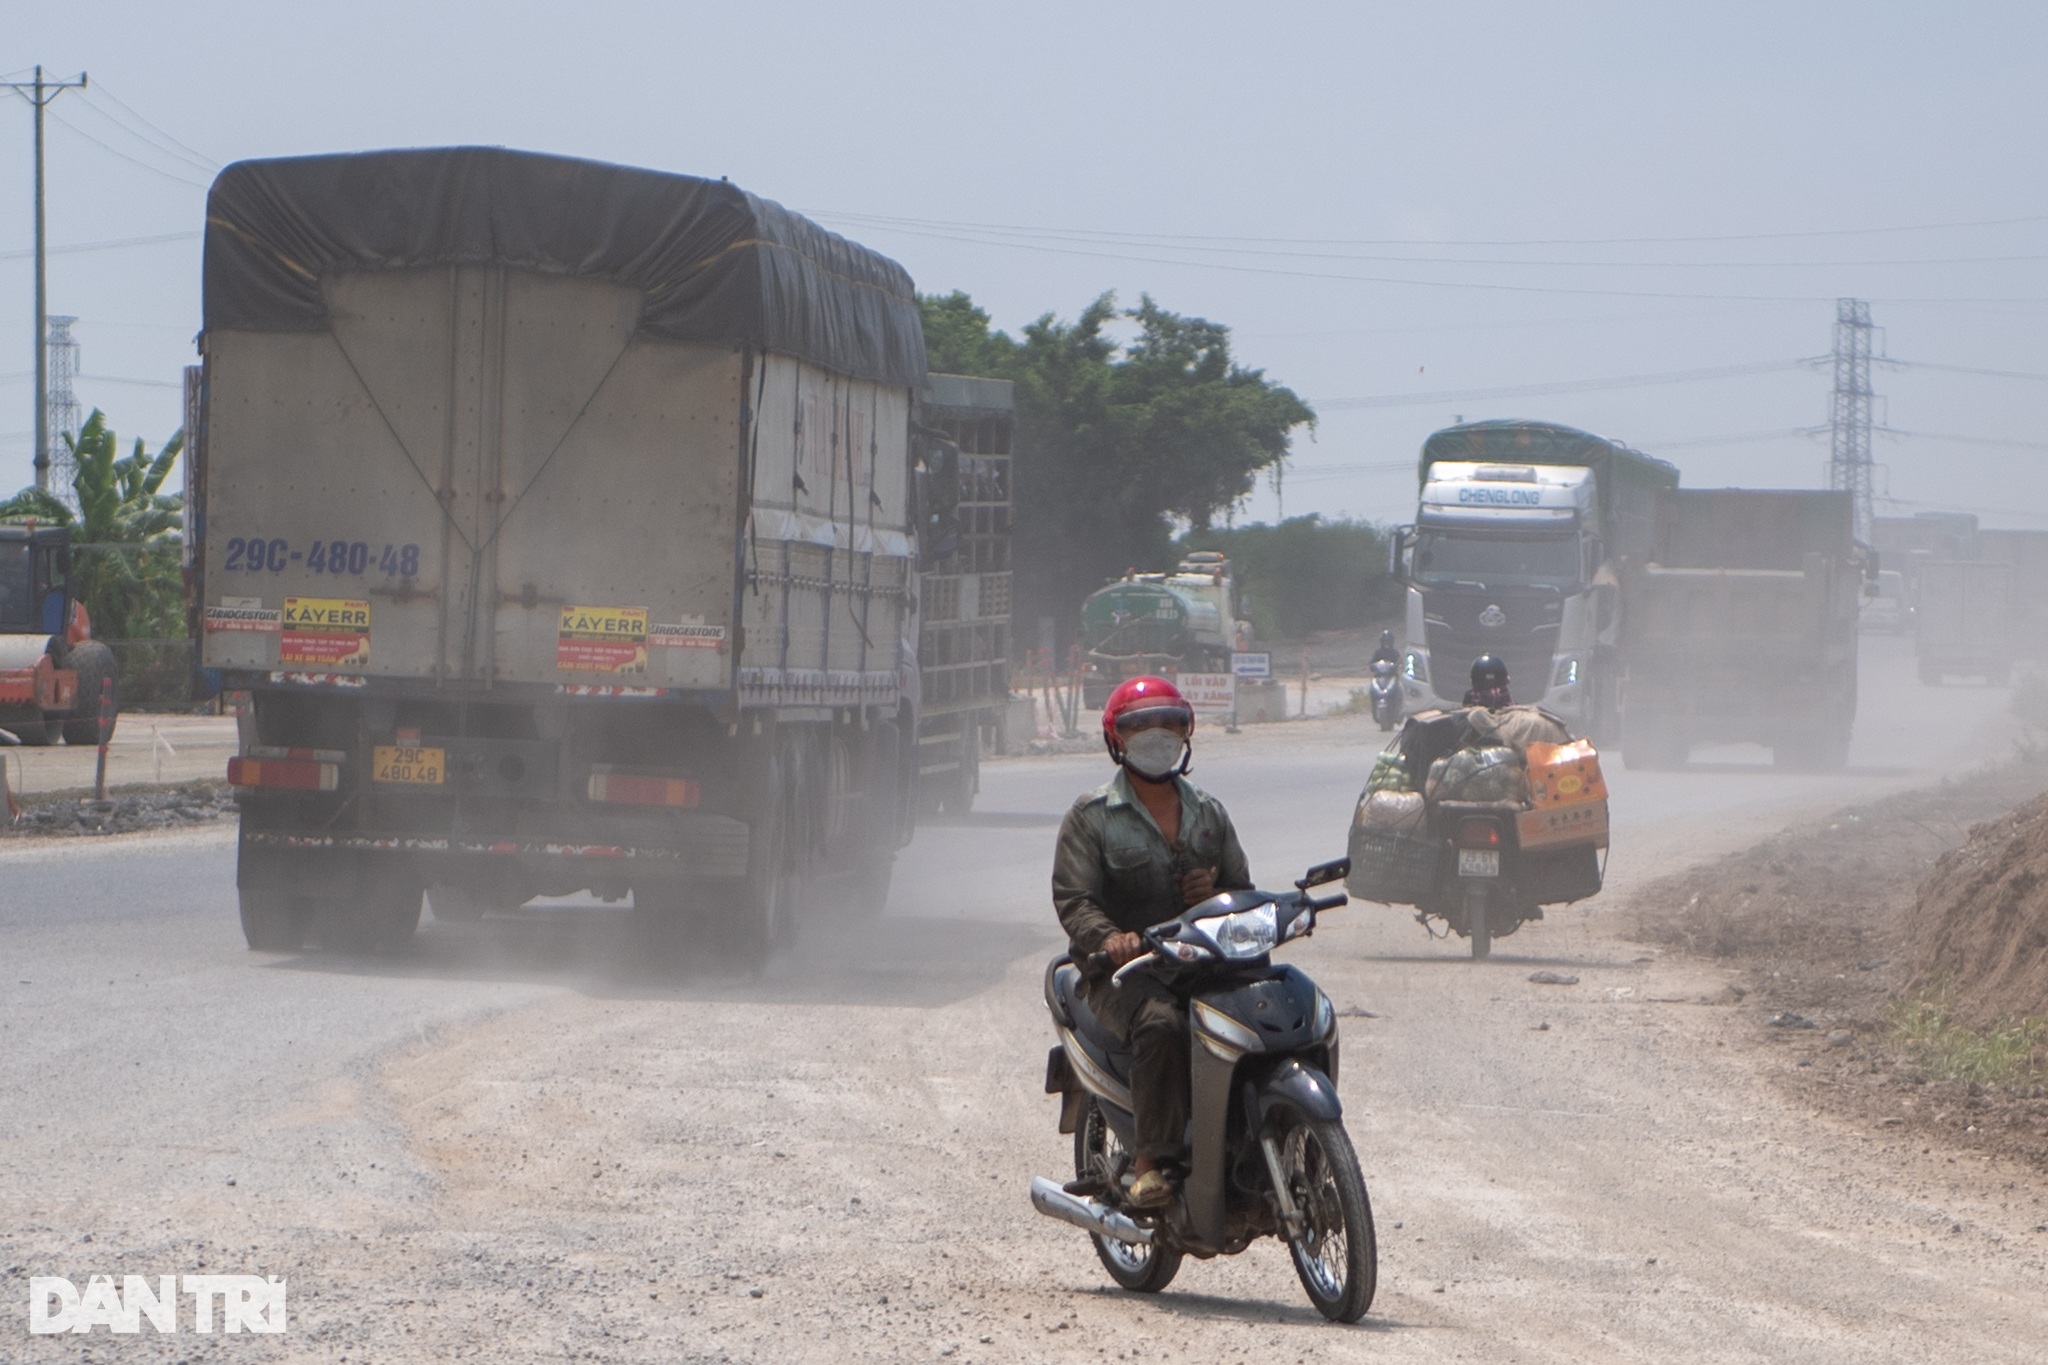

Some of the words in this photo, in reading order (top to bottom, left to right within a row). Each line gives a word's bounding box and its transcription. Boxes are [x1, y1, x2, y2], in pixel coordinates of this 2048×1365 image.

[1459, 488, 1540, 504] CHENGLONG
[286, 604, 366, 624] KÄYERR
[563, 613, 643, 632] KÄYERR
[650, 624, 722, 637] BRIDGESTONE
[394, 748, 424, 763] 29C
[380, 765, 437, 781] 480.48
